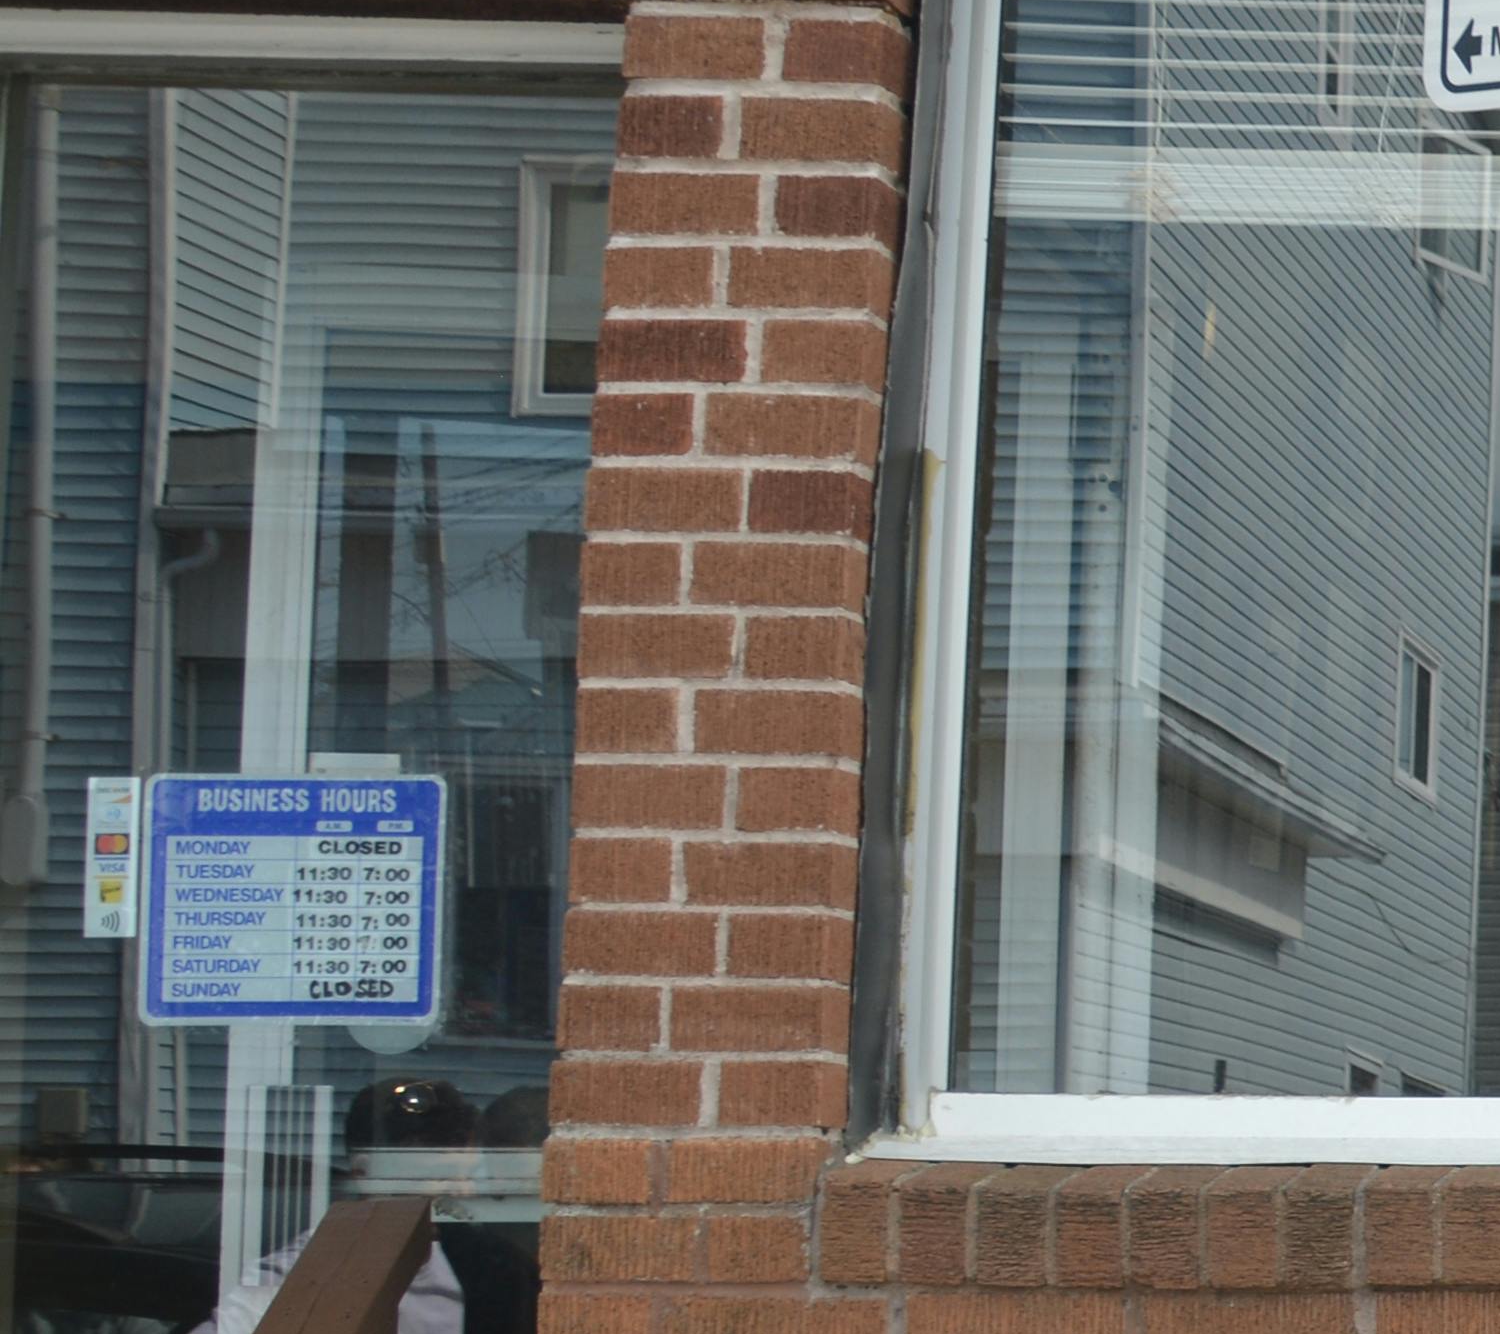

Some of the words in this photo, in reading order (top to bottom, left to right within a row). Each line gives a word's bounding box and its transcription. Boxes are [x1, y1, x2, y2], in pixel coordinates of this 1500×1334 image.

[197, 788, 310, 813] BUSINESS
[320, 787, 397, 813] HOURS
[175, 840, 251, 855] MONDAY
[317, 840, 403, 855] CLOSED
[98, 863, 127, 873] VISA
[175, 864, 255, 879] TUESDAY
[297, 867, 353, 881] 11:30
[363, 867, 410, 882] 7:00
[175, 887, 284, 902] WEDNESDAY
[293, 889, 348, 904] 11:30
[363, 890, 410, 905] 7:00
[174, 911, 267, 926] THURSDAY
[296, 914, 352, 929] 11:30
[172, 935, 233, 950] FRIDAY
[293, 936, 351, 951] 11:30
[171, 958, 261, 974] SATURDAY
[292, 960, 350, 975] 11:30
[359, 959, 407, 974] 7:00
[171, 982, 242, 998] SUNDAY
[309, 978, 395, 999] CLOSED
